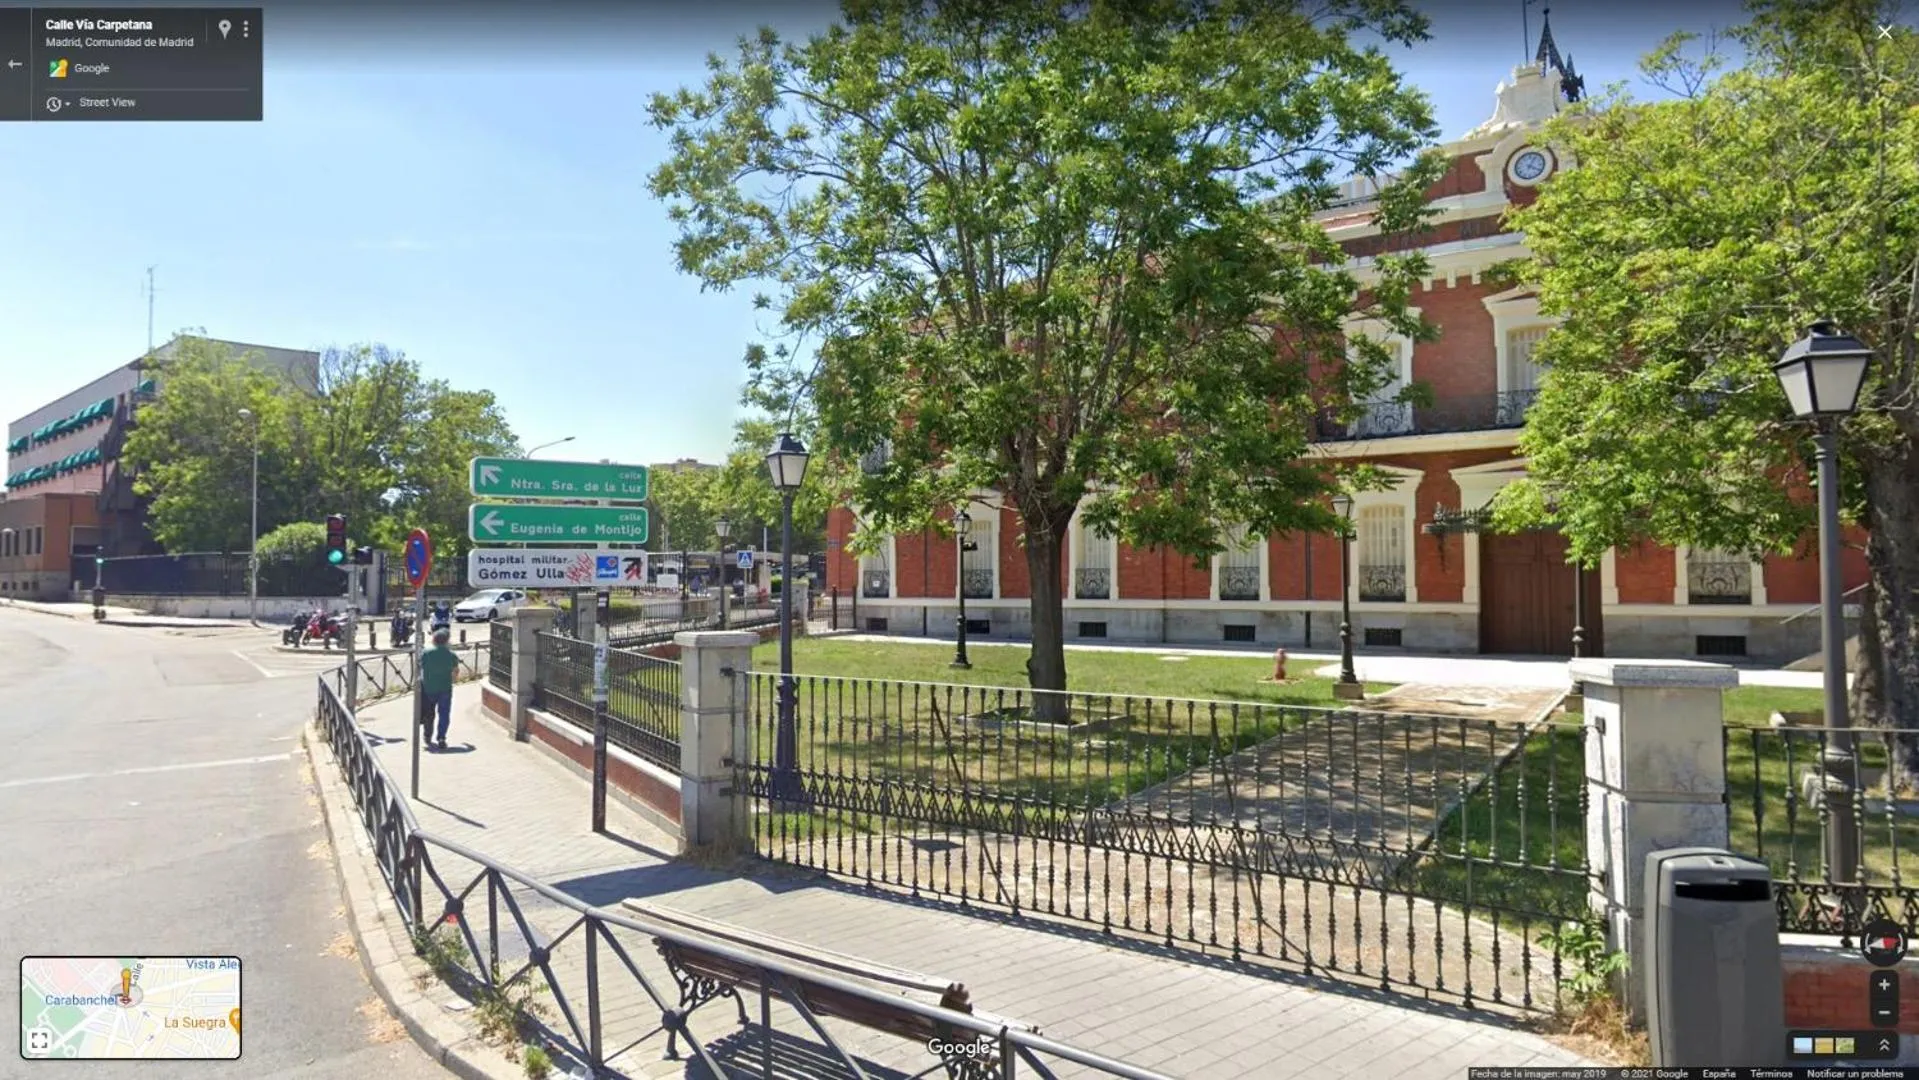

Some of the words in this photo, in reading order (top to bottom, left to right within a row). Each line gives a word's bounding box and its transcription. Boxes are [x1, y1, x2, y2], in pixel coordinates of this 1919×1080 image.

[511, 479, 545, 490] Ntra.
[552, 481, 578, 492] Sra.
[584, 482, 599, 492] de
[605, 482, 616, 493] la
[622, 484, 642, 494] Luz
[619, 514, 642, 523] calle
[511, 523, 563, 536] Eugenia
[572, 524, 587, 535] de
[595, 524, 642, 537] Montijo
[478, 555, 525, 566] hospital
[531, 556, 568, 565] militar
[478, 568, 528, 581] Gómez
[536, 568, 565, 580] Ulla
